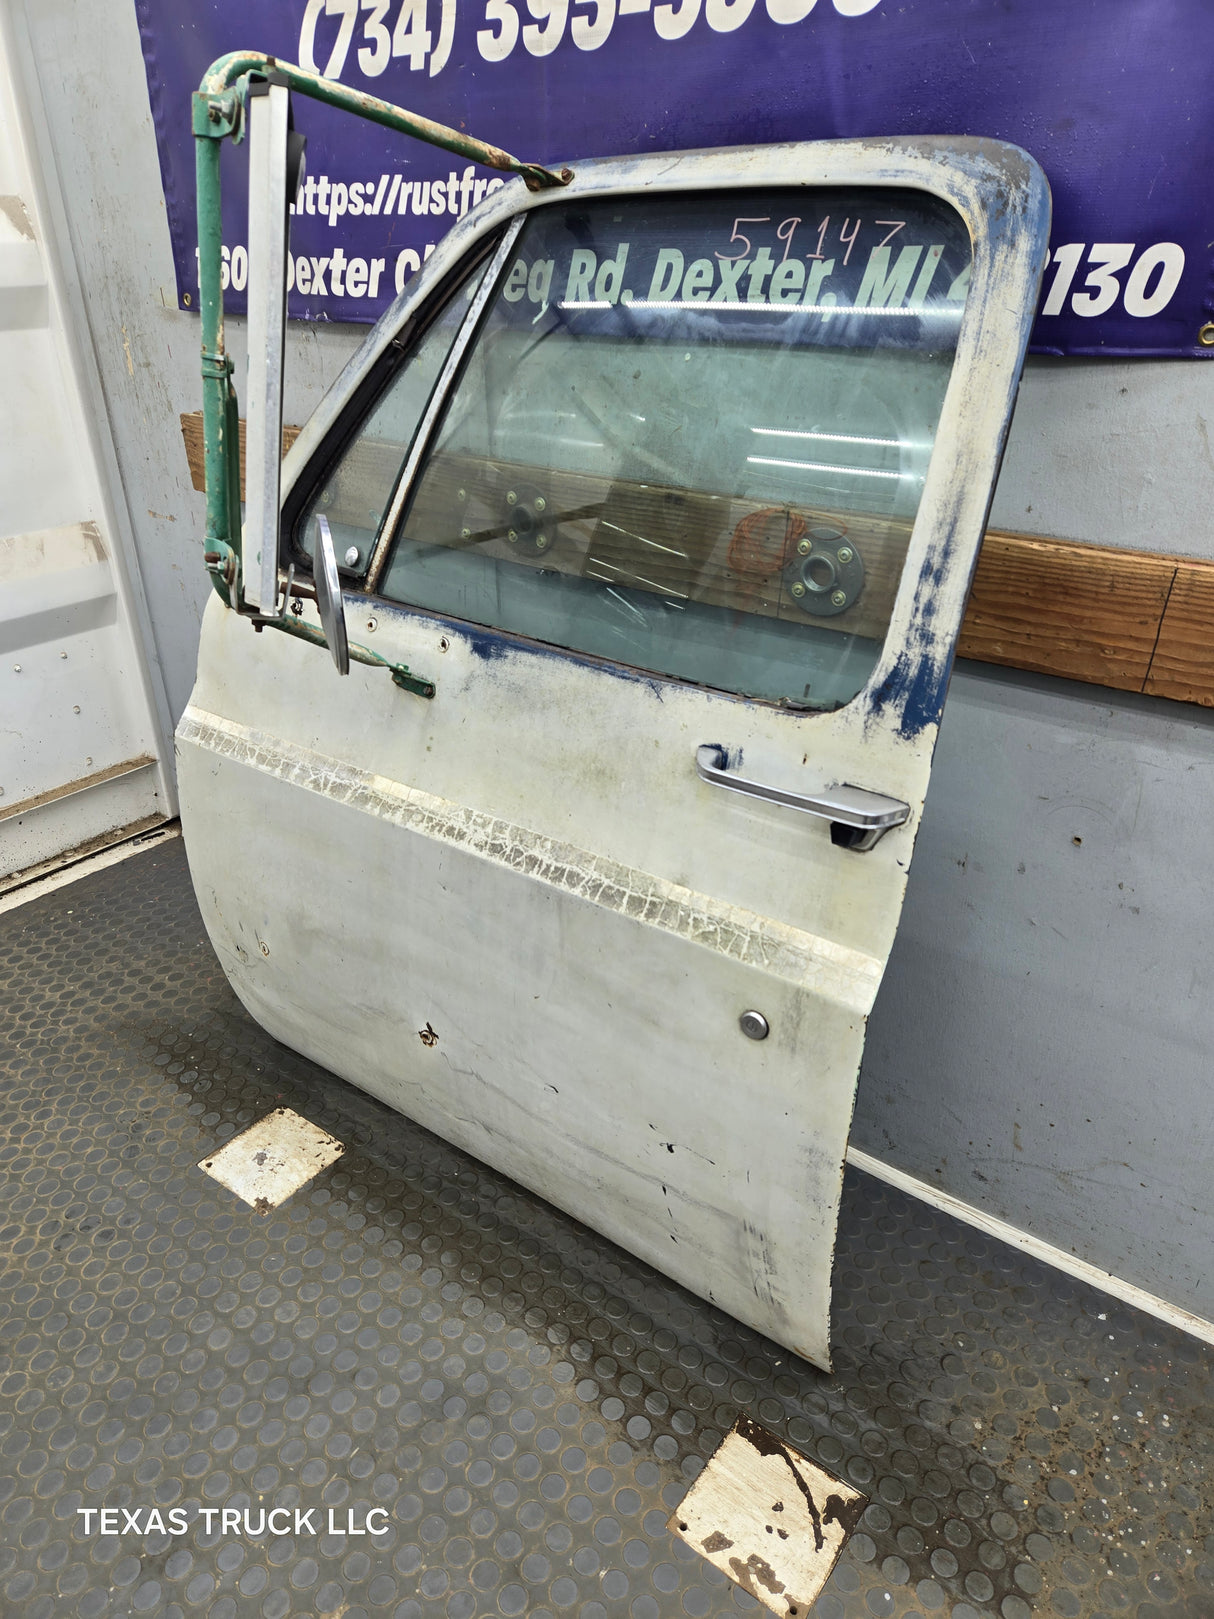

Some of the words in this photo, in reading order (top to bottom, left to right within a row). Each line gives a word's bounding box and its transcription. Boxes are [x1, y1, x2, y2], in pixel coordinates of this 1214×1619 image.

[714, 215, 906, 266] 59147
[564, 243, 634, 305] Rd.
[647, 246, 838, 322] Dexter,
[854, 244, 945, 308] MI
